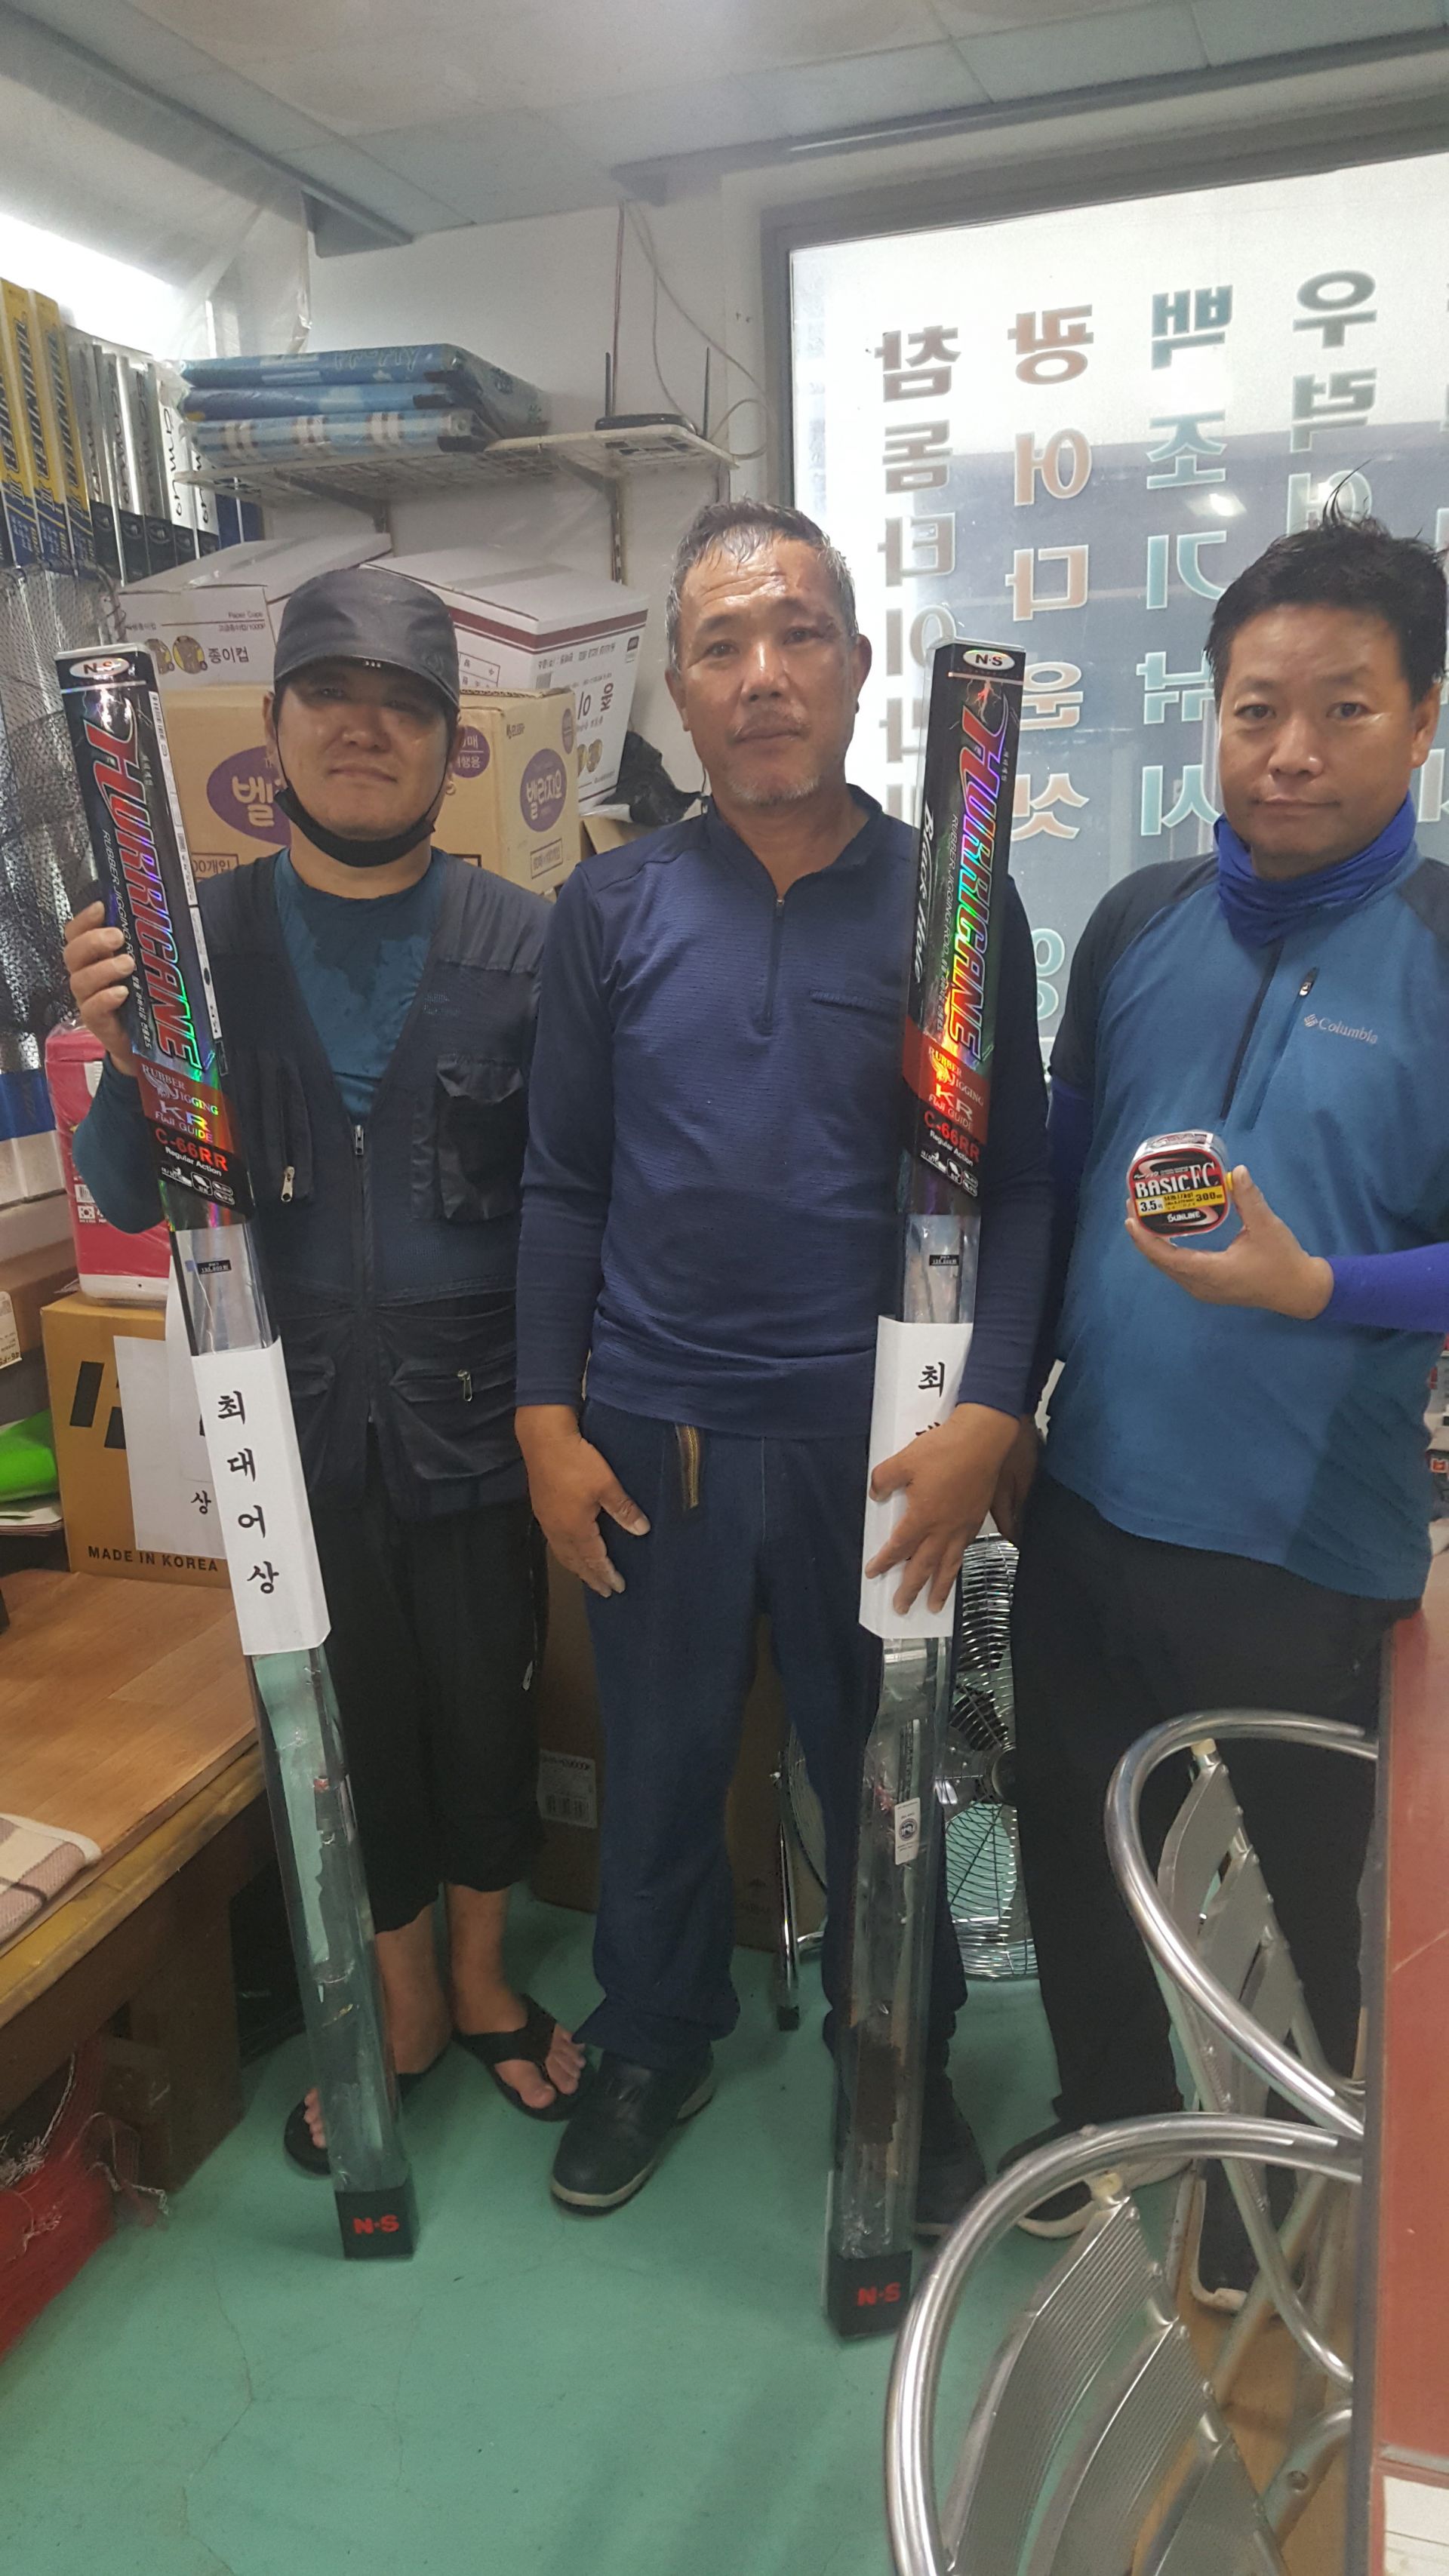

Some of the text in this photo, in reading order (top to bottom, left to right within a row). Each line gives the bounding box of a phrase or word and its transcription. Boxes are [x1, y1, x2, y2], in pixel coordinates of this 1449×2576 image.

[208, 646, 250, 666] 종이컵
[948, 814, 958, 871] RUBBER
[82, 698, 203, 1073] HURRICANE
[101, 829, 120, 886] RUBBER
[112, 884, 131, 941] JIGGING
[949, 697, 1008, 1059] HURRICANE
[943, 869, 954, 925] JIGGING
[1318, 1016, 1378, 1045] Columbia
[142, 1064, 186, 1091] RUBBER
[928, 1047, 962, 1077] RUBBER
[174, 1088, 219, 1116] JIGGING
[949, 1073, 984, 1106] JIGGING
[159, 1100, 211, 1132] KR
[180, 1122, 214, 1142] GUIDE
[948, 1108, 974, 1132] GUIDE
[155, 1128, 228, 1171] C-66RR
[924, 1111, 980, 1163] C-66RR
[930, 1130, 953, 1152] Regular
[954, 1148, 974, 1167] Action
[165, 1146, 195, 1166] Regular
[196, 1161, 223, 1177] Action
[1134, 1175, 1191, 1199] BASIC
[1189, 1161, 1219, 1189] FC
[190, 1490, 212, 1514] 상
[88, 1545, 218, 1572] MADE IN KOREA
